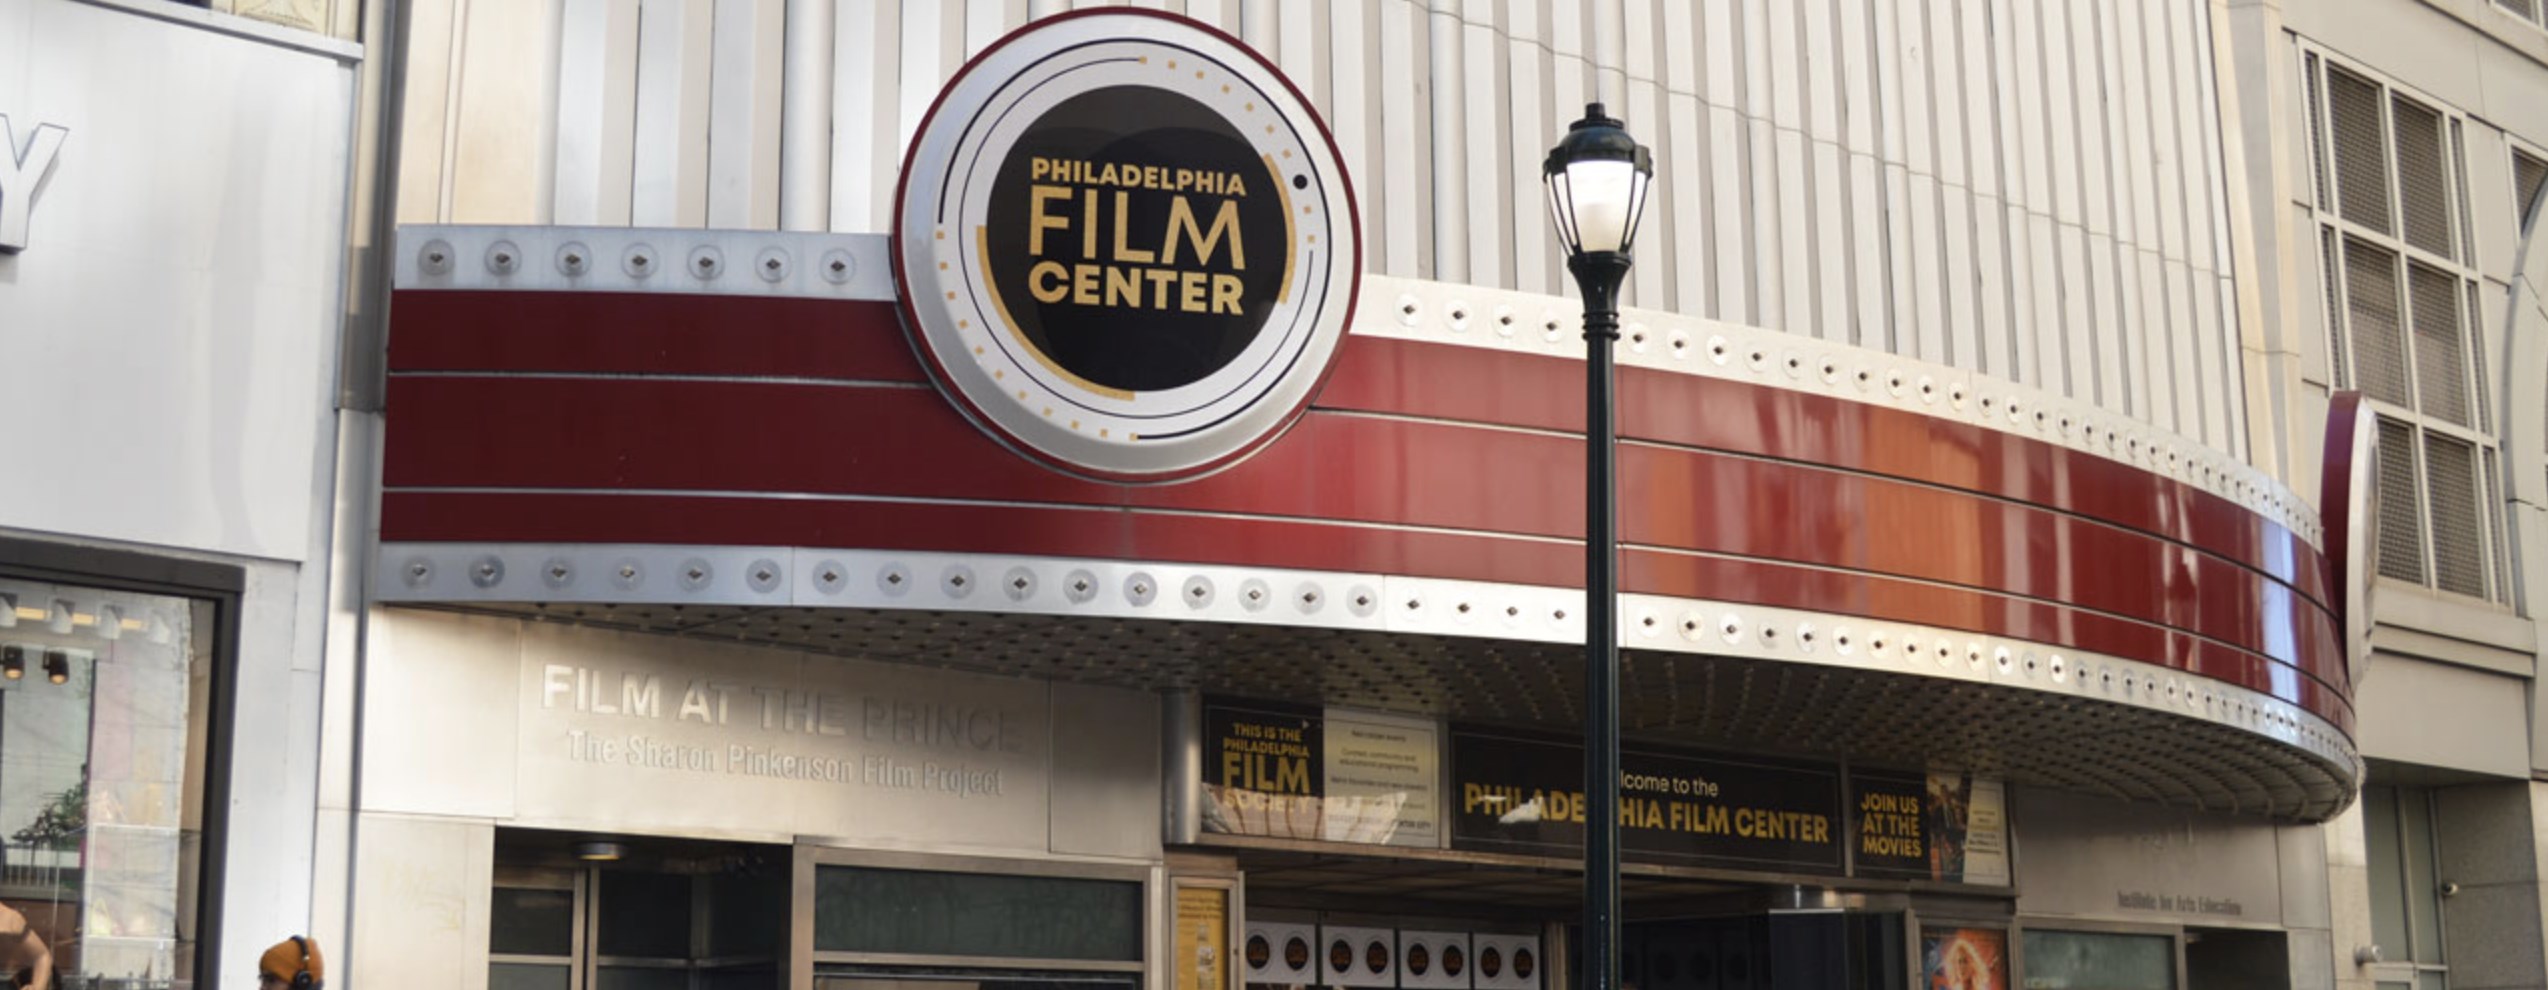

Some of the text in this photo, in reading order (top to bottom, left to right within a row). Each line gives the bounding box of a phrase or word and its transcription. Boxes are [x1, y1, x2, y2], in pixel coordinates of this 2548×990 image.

[1031, 157, 1247, 196] PHILADELPHIA
[1029, 184, 1246, 270] FILM
[1028, 260, 1244, 315] CENTER
[542, 664, 1024, 752] FILM AT THE PRINCE
[1222, 737, 1310, 758] PHILADELPHIA
[1233, 723, 1303, 743] THIS IS THE
[566, 730, 1003, 799] The Sharon Pinkenson Film Project
[1222, 751, 1311, 795] FILM
[1619, 769, 1719, 797] lcome to the
[1463, 781, 1665, 830] PHIADEHIA
[1670, 801, 1731, 836] FILM
[1734, 807, 1830, 844] CENTER
[1861, 792, 1920, 815] JOIN US
[1862, 812, 1921, 838] AT THE
[1863, 835, 1923, 858] MOVIES
